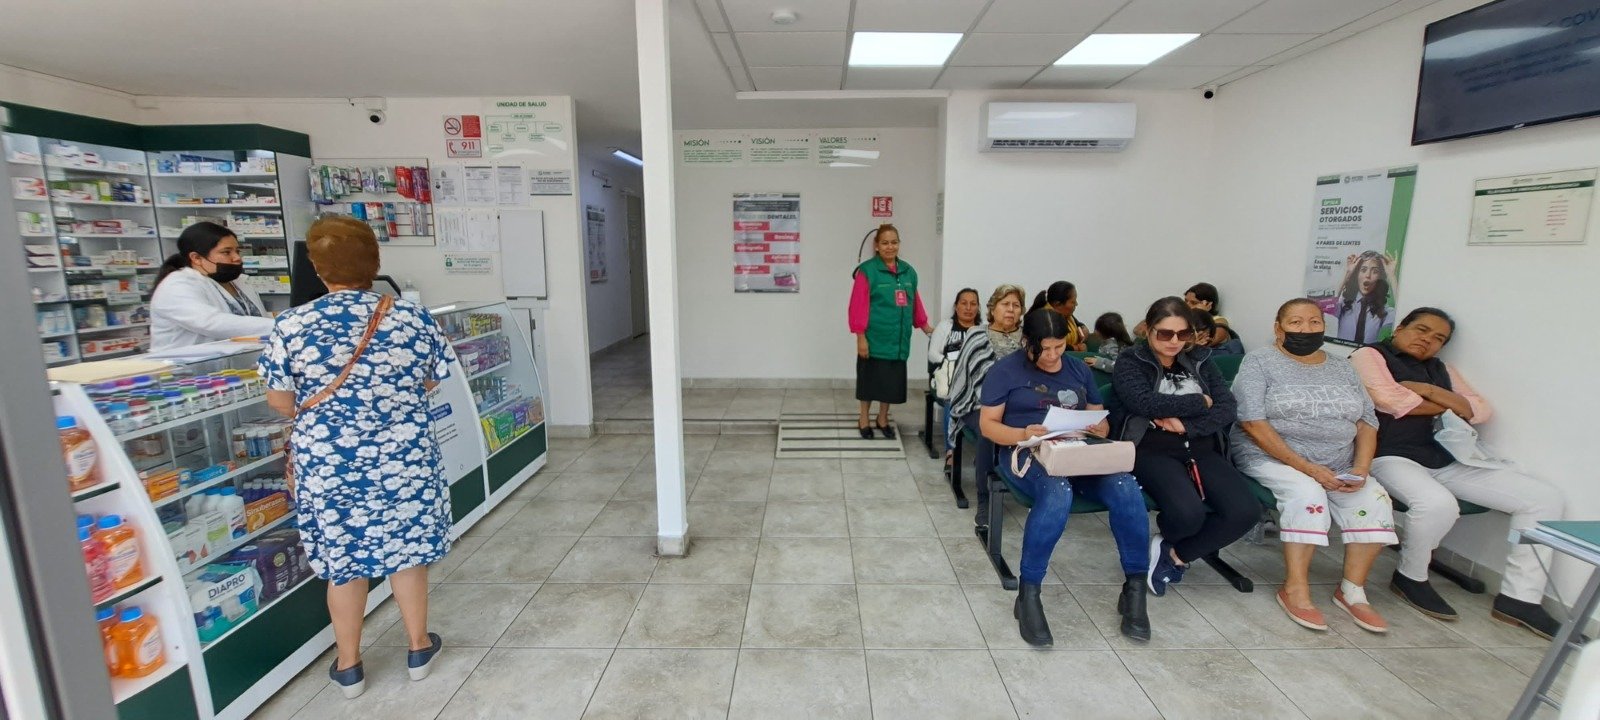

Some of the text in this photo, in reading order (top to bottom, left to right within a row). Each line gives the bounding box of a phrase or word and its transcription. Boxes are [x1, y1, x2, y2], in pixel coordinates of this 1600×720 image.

[683, 138, 710, 147] MISIÓN
[751, 137, 776, 145] VISIÓN
[819, 136, 848, 144] VALORES
[461, 141, 475, 150] 911
[1320, 205, 1364, 215] SERVICIOS
[1319, 215, 1362, 223] OTORGADOS
[207, 573, 246, 598] DIAPRO
